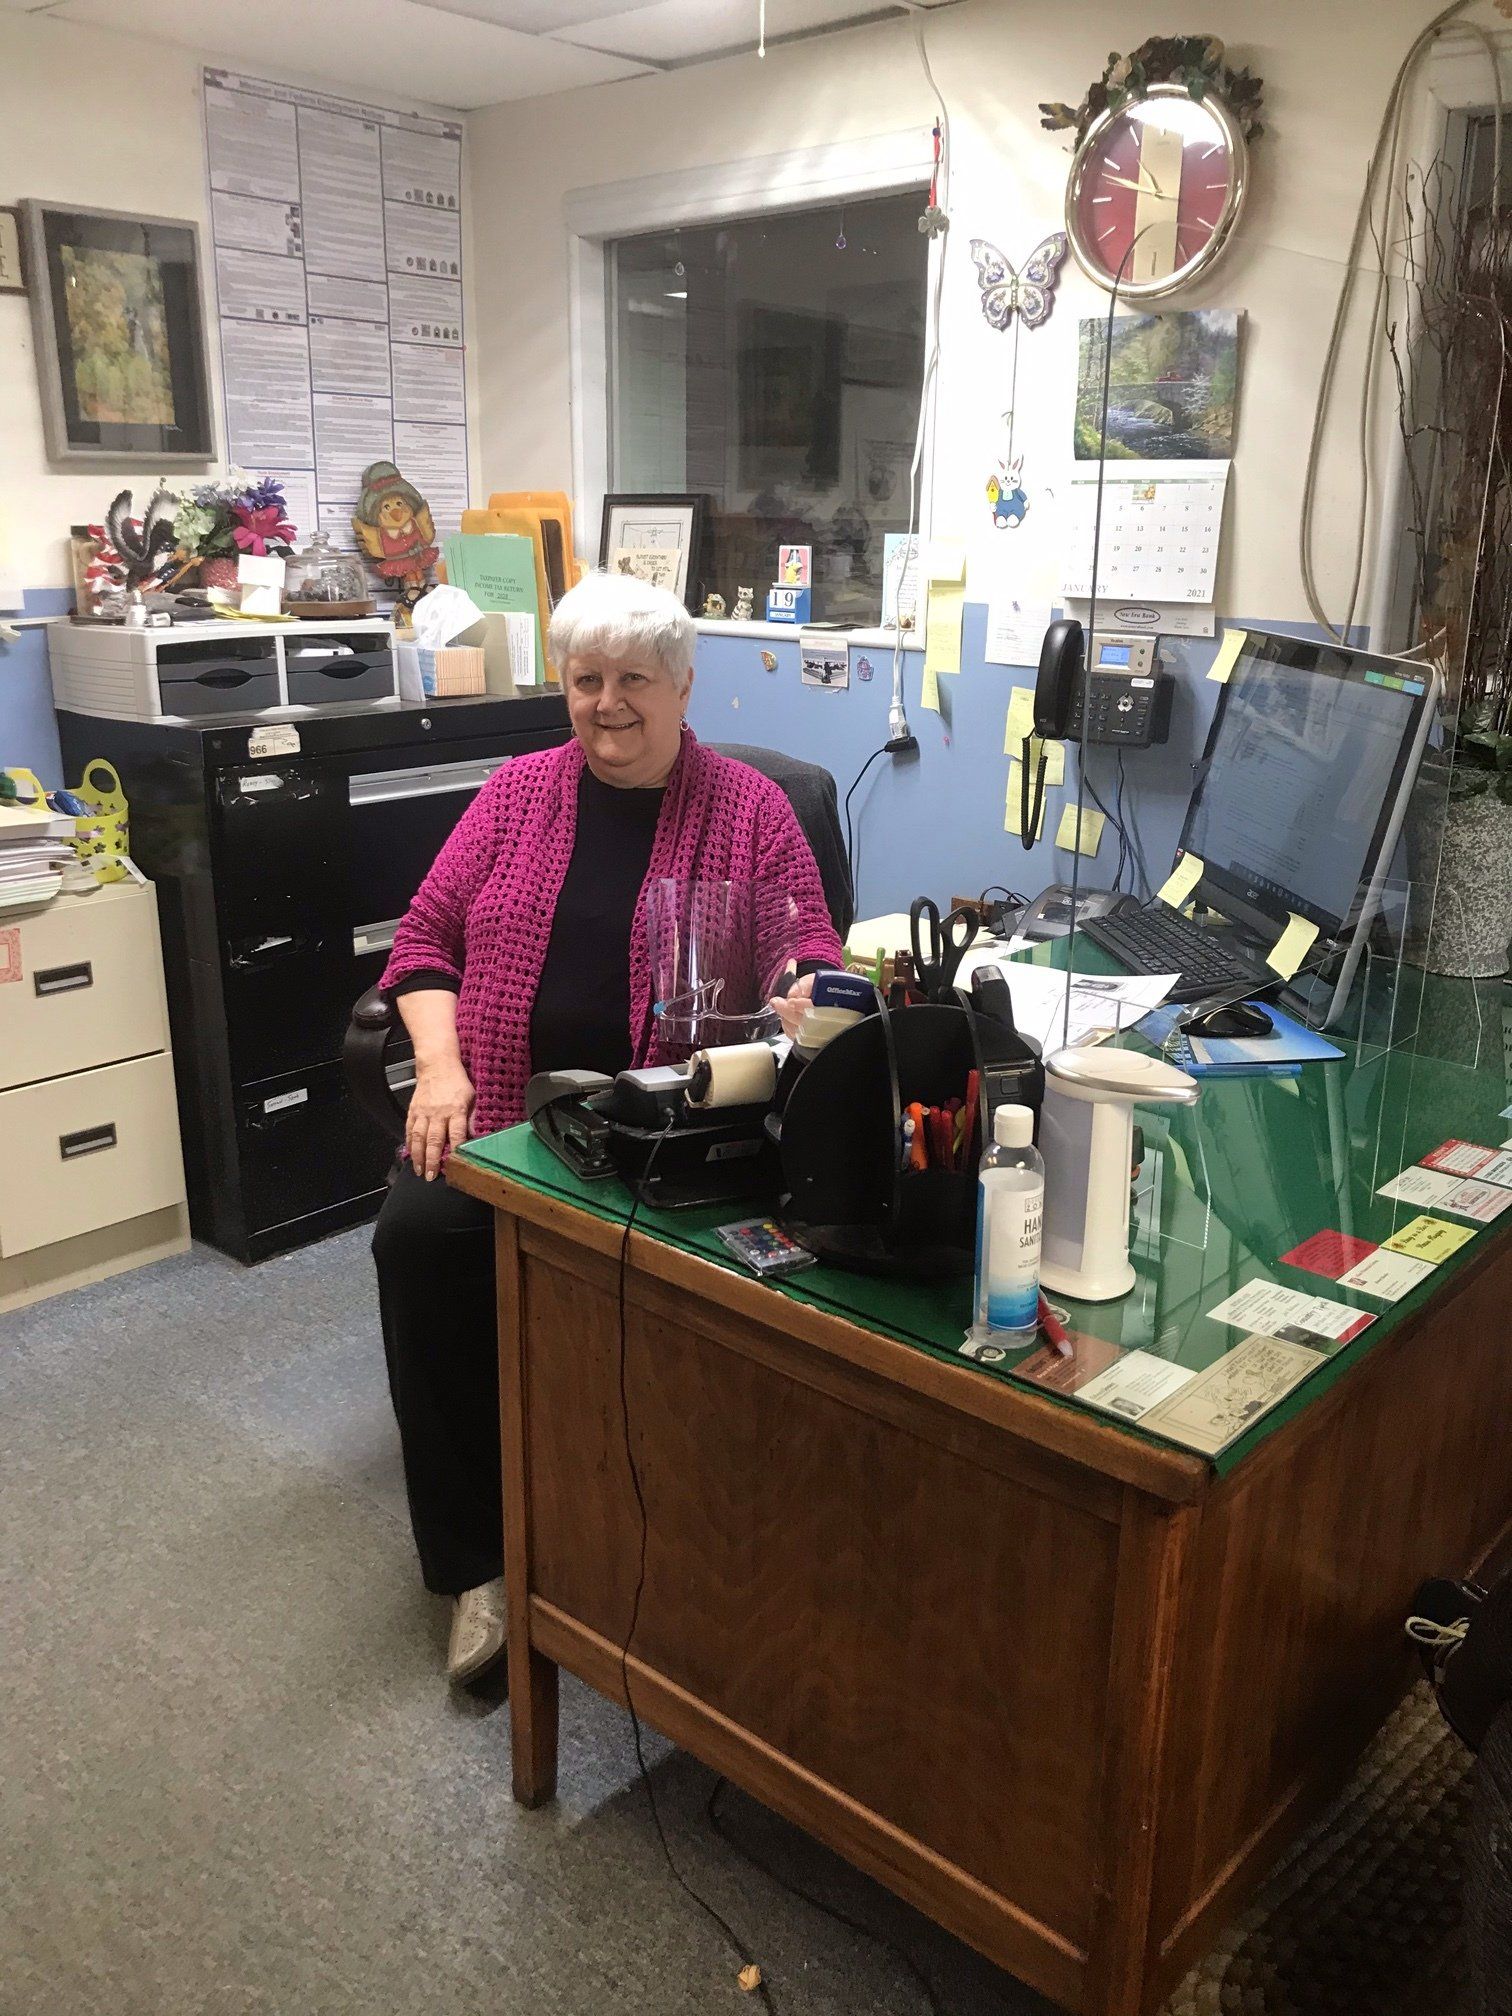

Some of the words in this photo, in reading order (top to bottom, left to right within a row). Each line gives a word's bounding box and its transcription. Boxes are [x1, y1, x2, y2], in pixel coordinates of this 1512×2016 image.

[1201, 546, 1209, 554] 23
[1186, 588, 1206, 598] 2021
[250, 744, 267, 755] 966
[1246, 888, 1260, 900] acer
[826, 986, 863, 997] OfficeMax
[1024, 1215, 1042, 1235] HAN
